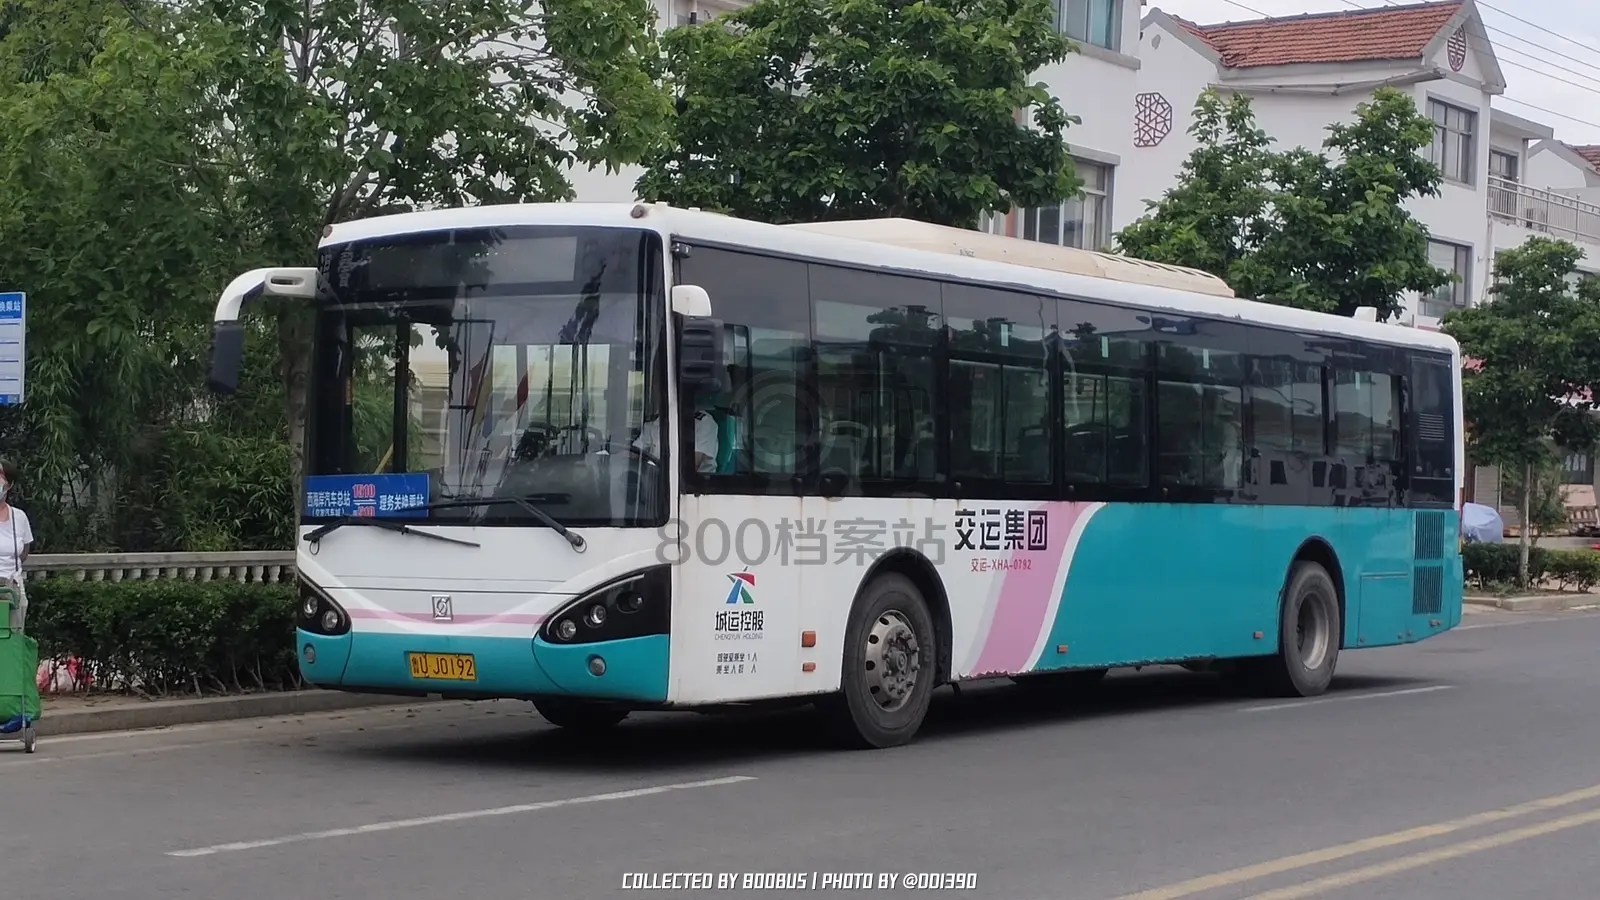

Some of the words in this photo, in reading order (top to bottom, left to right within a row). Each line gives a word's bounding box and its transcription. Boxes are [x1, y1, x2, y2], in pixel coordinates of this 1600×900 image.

[954, 508, 1048, 551] 交运集团
[715, 610, 764, 631] 城运控股
[715, 633, 741, 641] CHENGYUN
[743, 632, 763, 640] HOLDING
